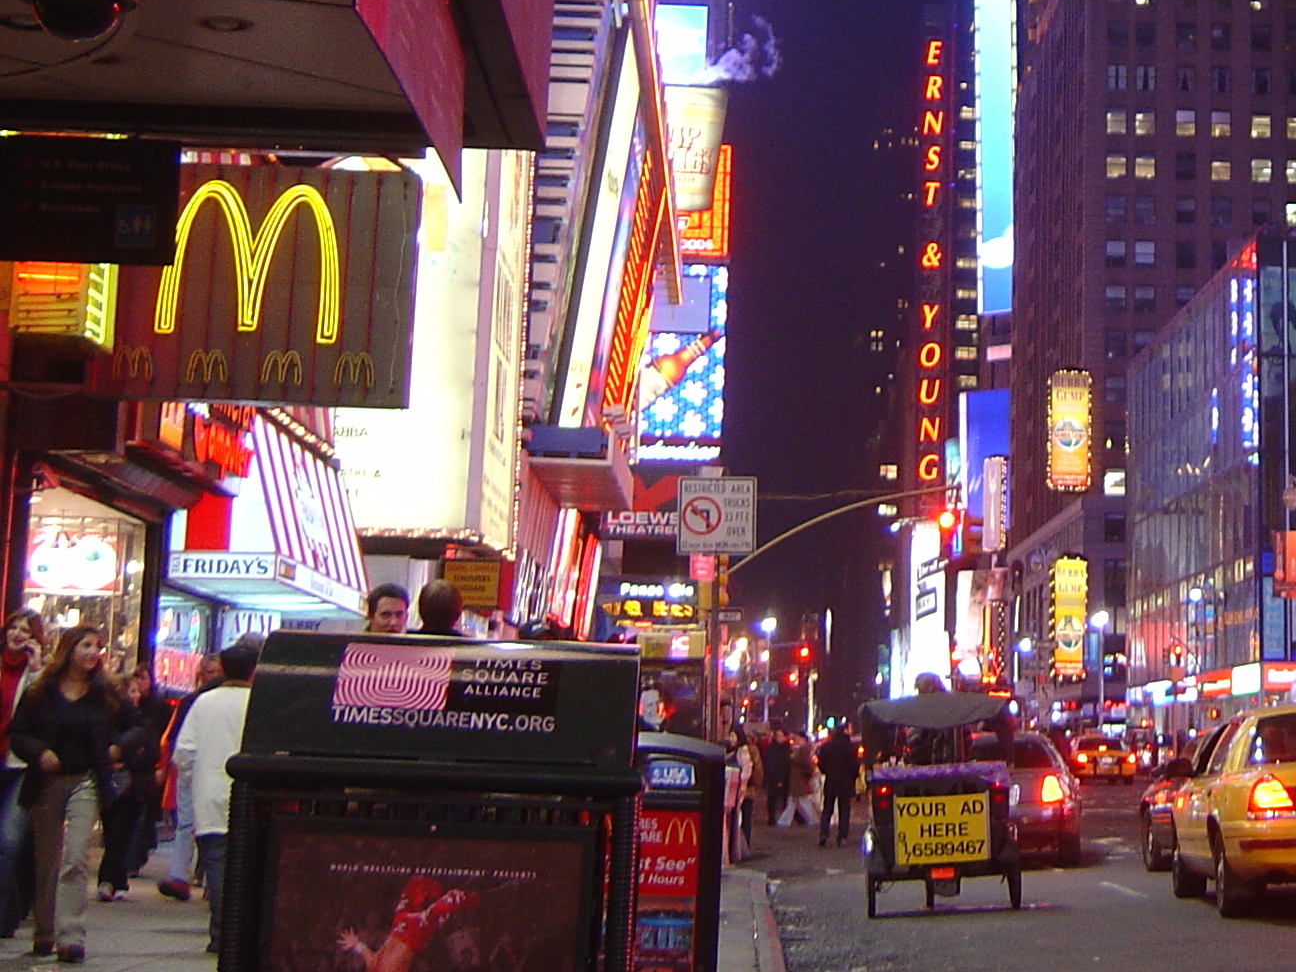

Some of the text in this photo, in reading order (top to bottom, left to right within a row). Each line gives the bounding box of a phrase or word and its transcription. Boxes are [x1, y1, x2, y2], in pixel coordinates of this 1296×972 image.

[921, 39, 943, 208] ERNST
[918, 303, 940, 482] YOUNG
[730, 481, 751, 494] AREA
[181, 556, 270, 577] FRIDAY'S
[461, 668, 549, 685] SQUARE
[464, 684, 542, 699] ALLIANCE
[332, 705, 555, 733] TIMESSQUARENYC.ORG
[897, 799, 985, 818] YOUR AD
[919, 821, 969, 839] HERE
[911, 840, 986, 858] 6589467
